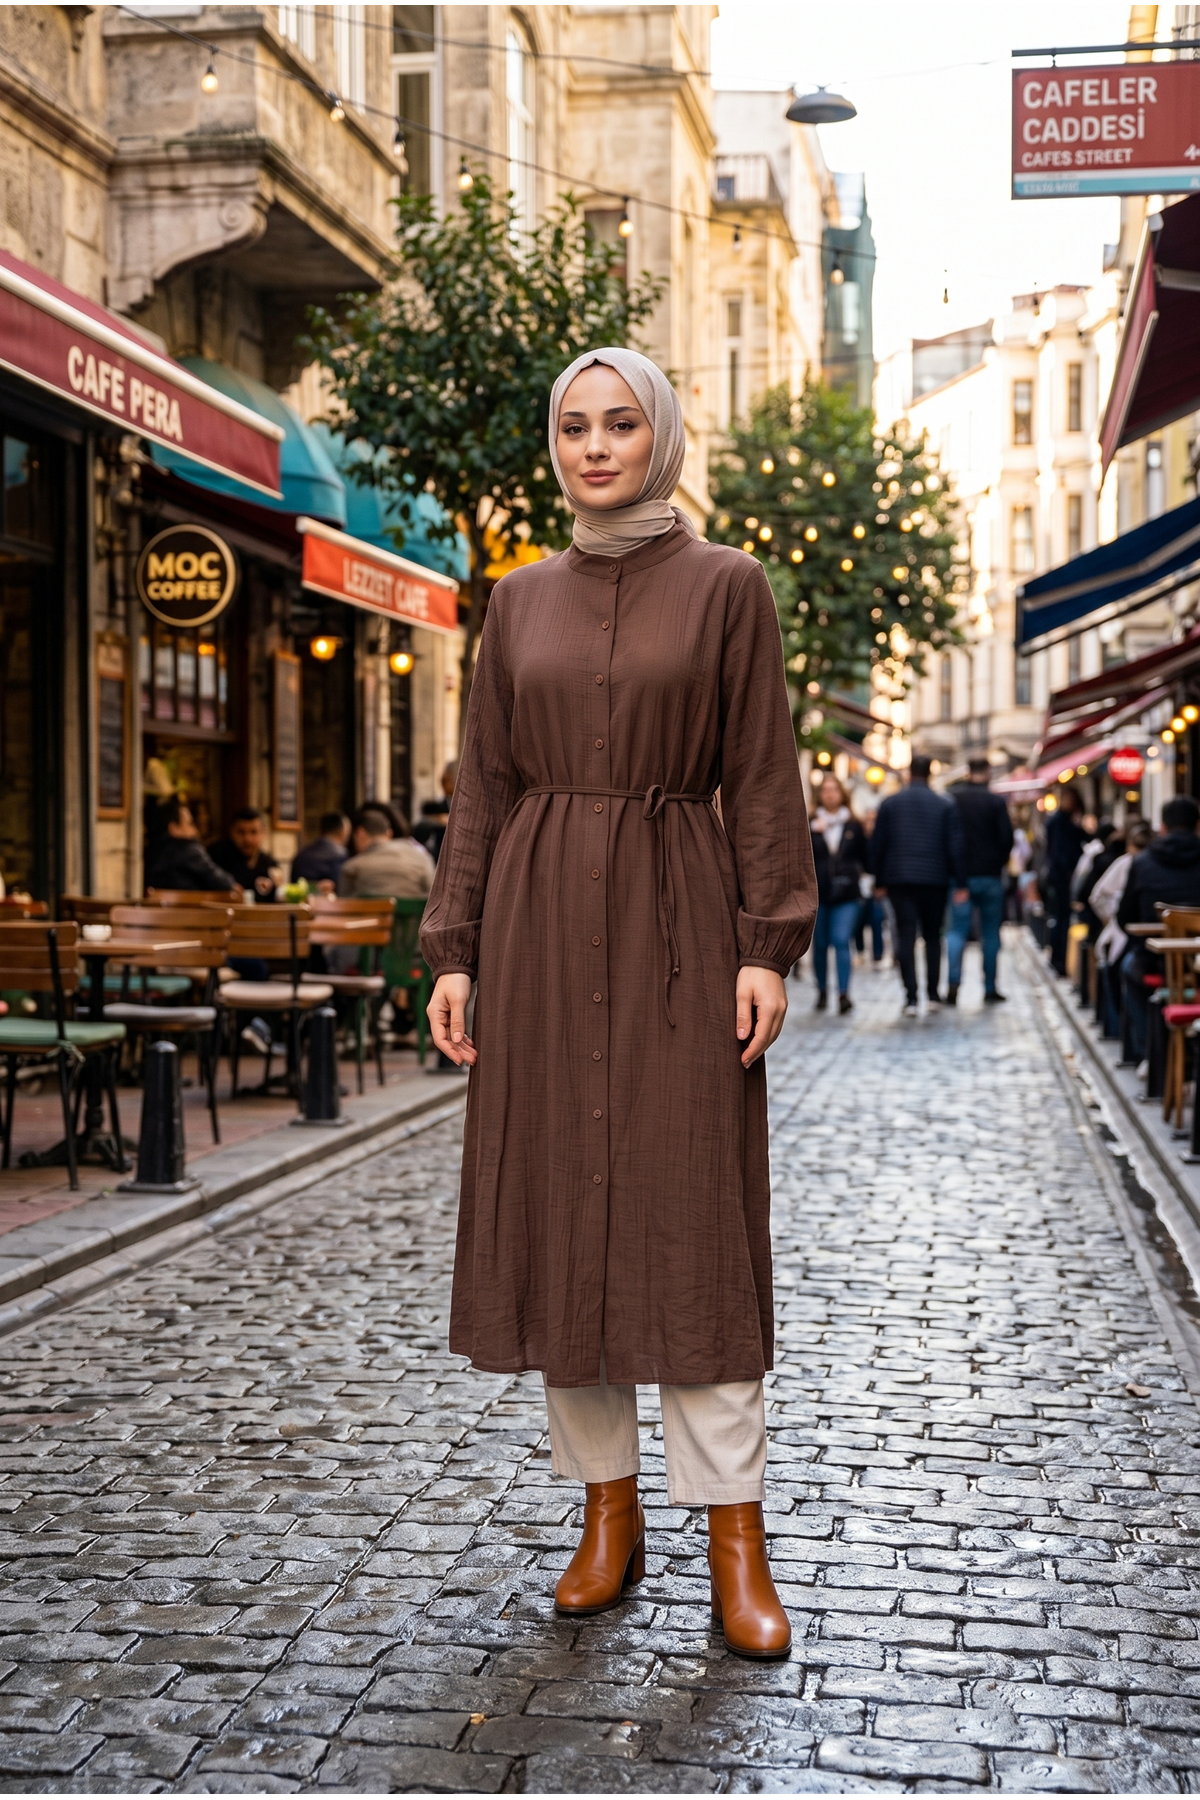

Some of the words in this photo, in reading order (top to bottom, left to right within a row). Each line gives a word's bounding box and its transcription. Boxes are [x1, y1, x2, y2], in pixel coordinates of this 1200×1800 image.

[1023, 76, 1158, 109] CAFELER
[1022, 108, 1146, 144] CADDESİ
[1021, 150, 1073, 168] CAFES
[1074, 148, 1134, 166] STREET
[130, 376, 183, 443] PERA
[147, 551, 221, 580] MOC
[147, 581, 221, 601] COFFEE
